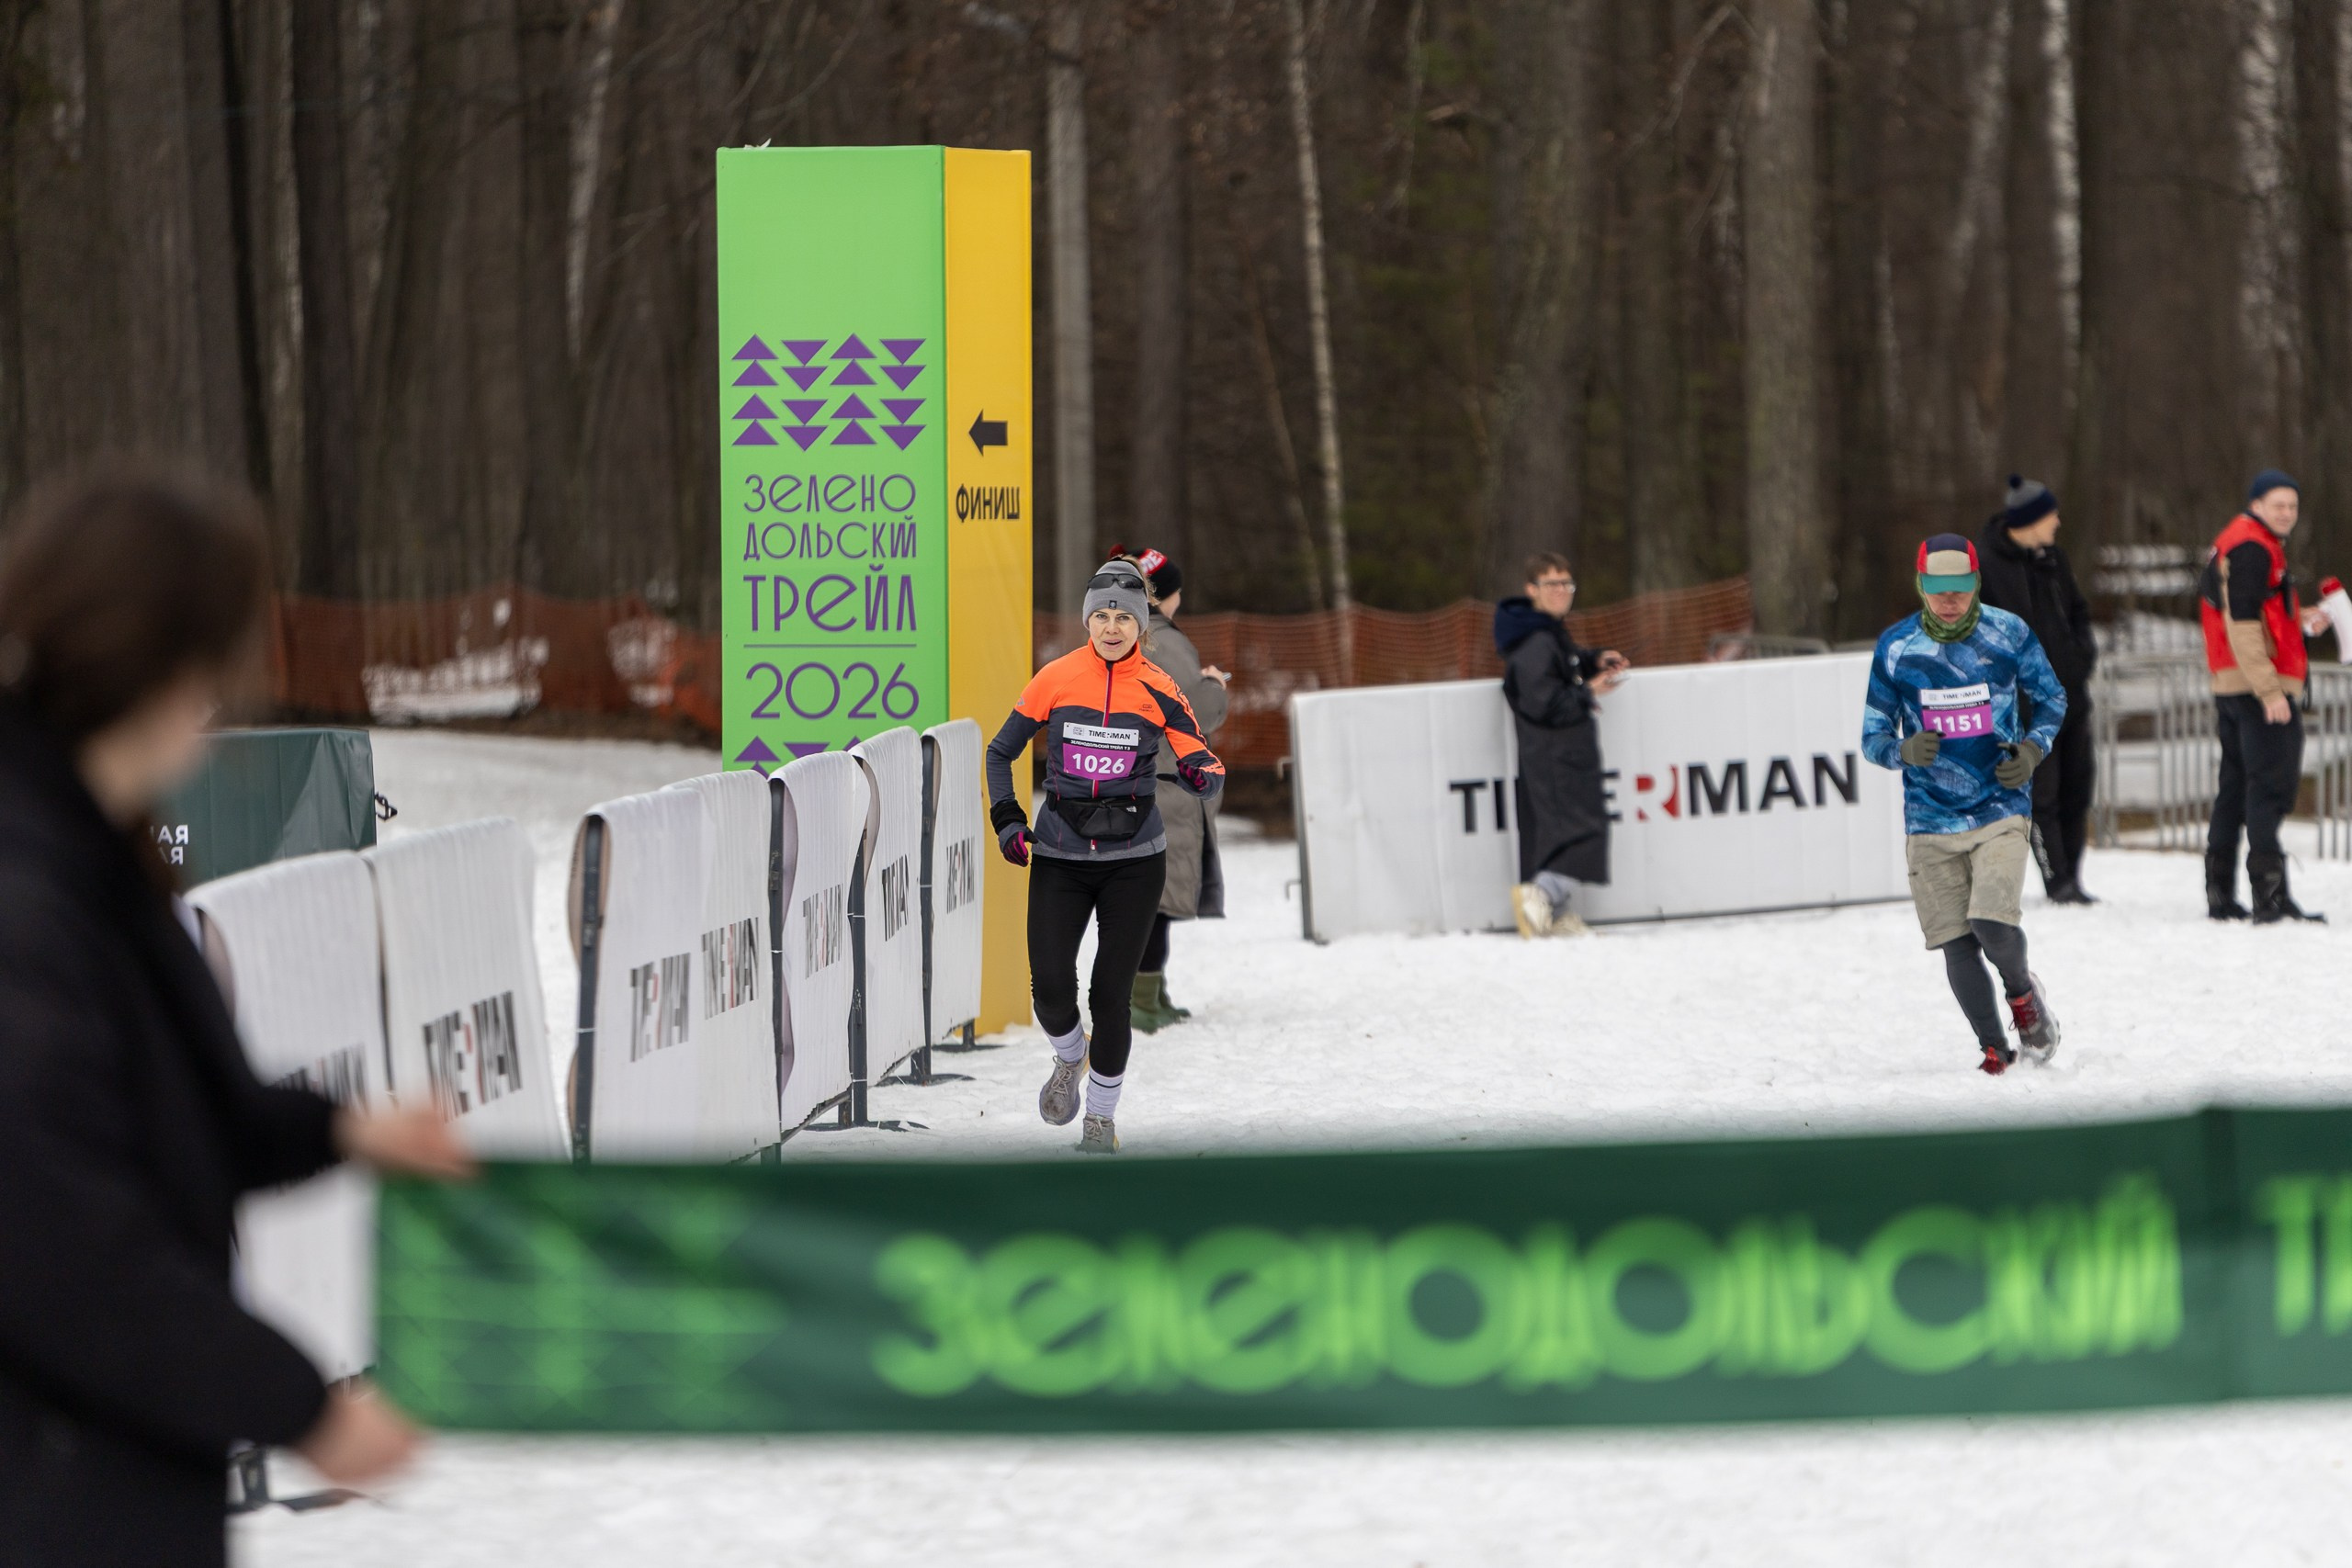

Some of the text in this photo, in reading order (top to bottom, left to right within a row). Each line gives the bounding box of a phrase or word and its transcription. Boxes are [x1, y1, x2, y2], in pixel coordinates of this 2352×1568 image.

[956, 483, 1021, 524] ФИНИШ
[742, 514, 917, 561] ДОЛЬСКИЙ
[742, 563, 918, 632] ТРЕЙЛ
[745, 661, 920, 720] 2026
[1933, 713, 1983, 733] 1151
[1072, 753, 1125, 774] 1026
